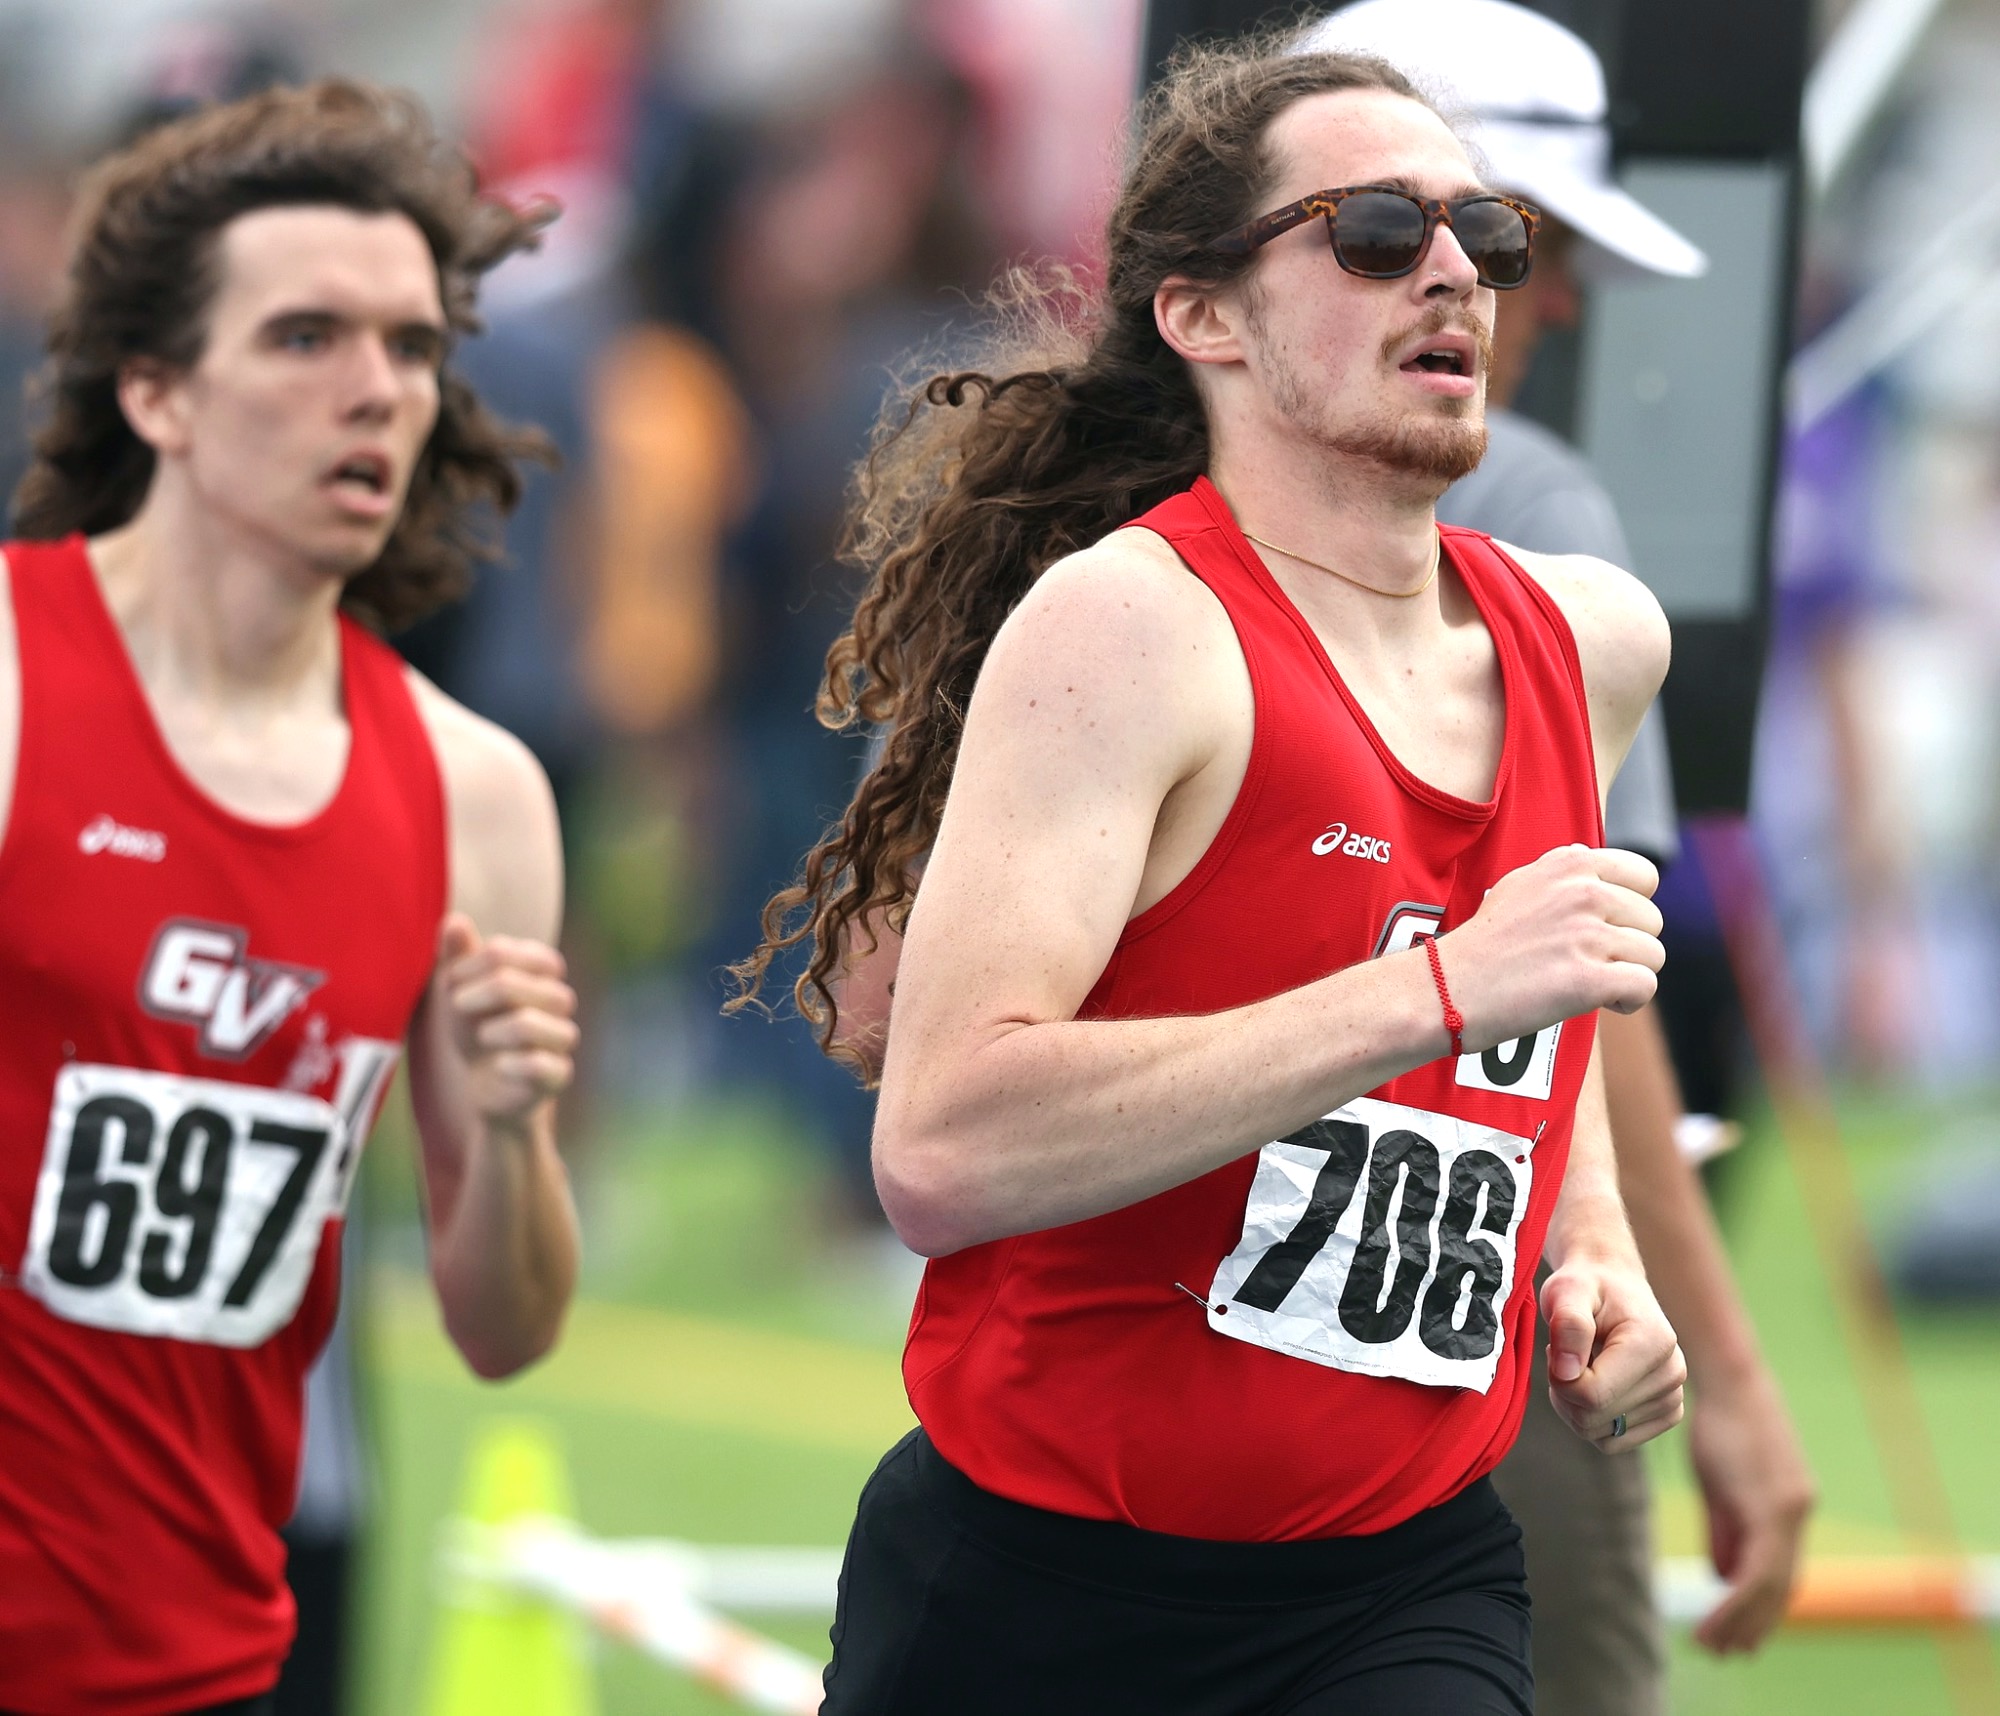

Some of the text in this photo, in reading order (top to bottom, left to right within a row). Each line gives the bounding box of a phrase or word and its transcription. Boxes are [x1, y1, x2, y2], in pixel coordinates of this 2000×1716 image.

[1342, 833, 1391, 863] asics
[140, 917, 325, 1060] GV
[49, 1095, 327, 1311] 697
[1232, 1119, 1517, 1361] 706
